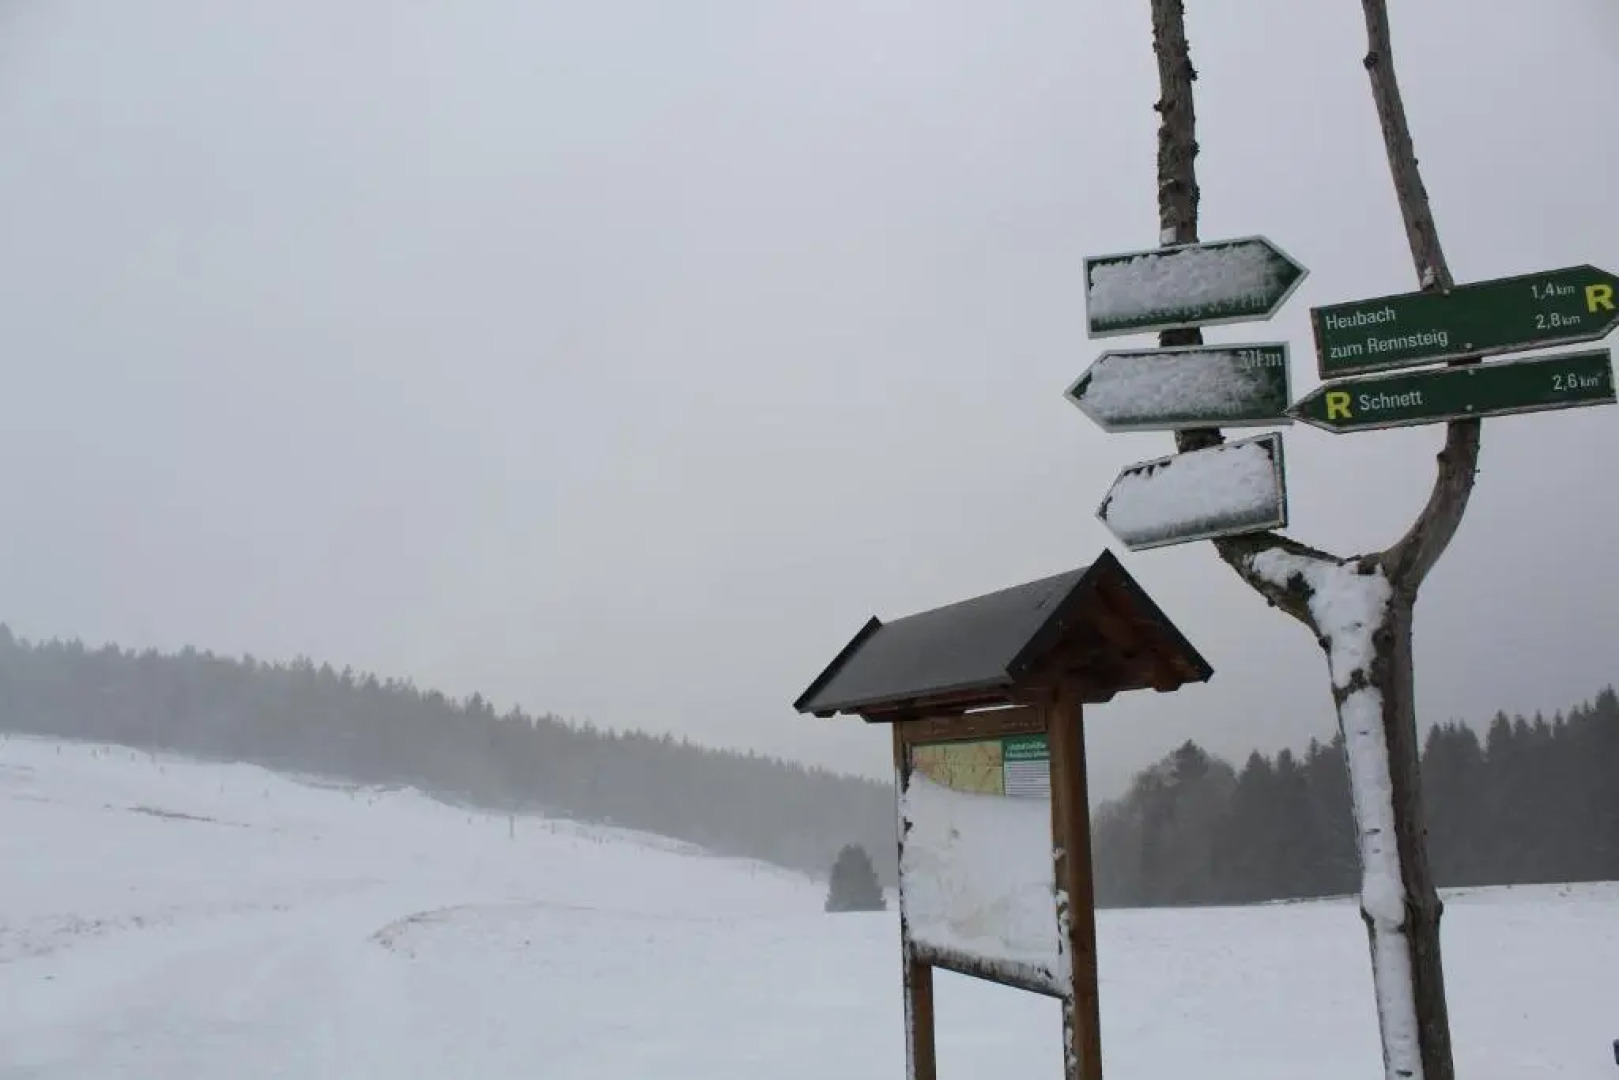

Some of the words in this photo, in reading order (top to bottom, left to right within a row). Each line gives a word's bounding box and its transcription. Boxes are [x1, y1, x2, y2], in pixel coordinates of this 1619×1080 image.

[1585, 284, 1616, 313] R
[1325, 305, 1396, 330] Heubach
[1330, 343, 1362, 358] zum
[1367, 329, 1449, 354] Rennsteig
[1325, 391, 1352, 419] R
[1359, 391, 1423, 411] Schnett
